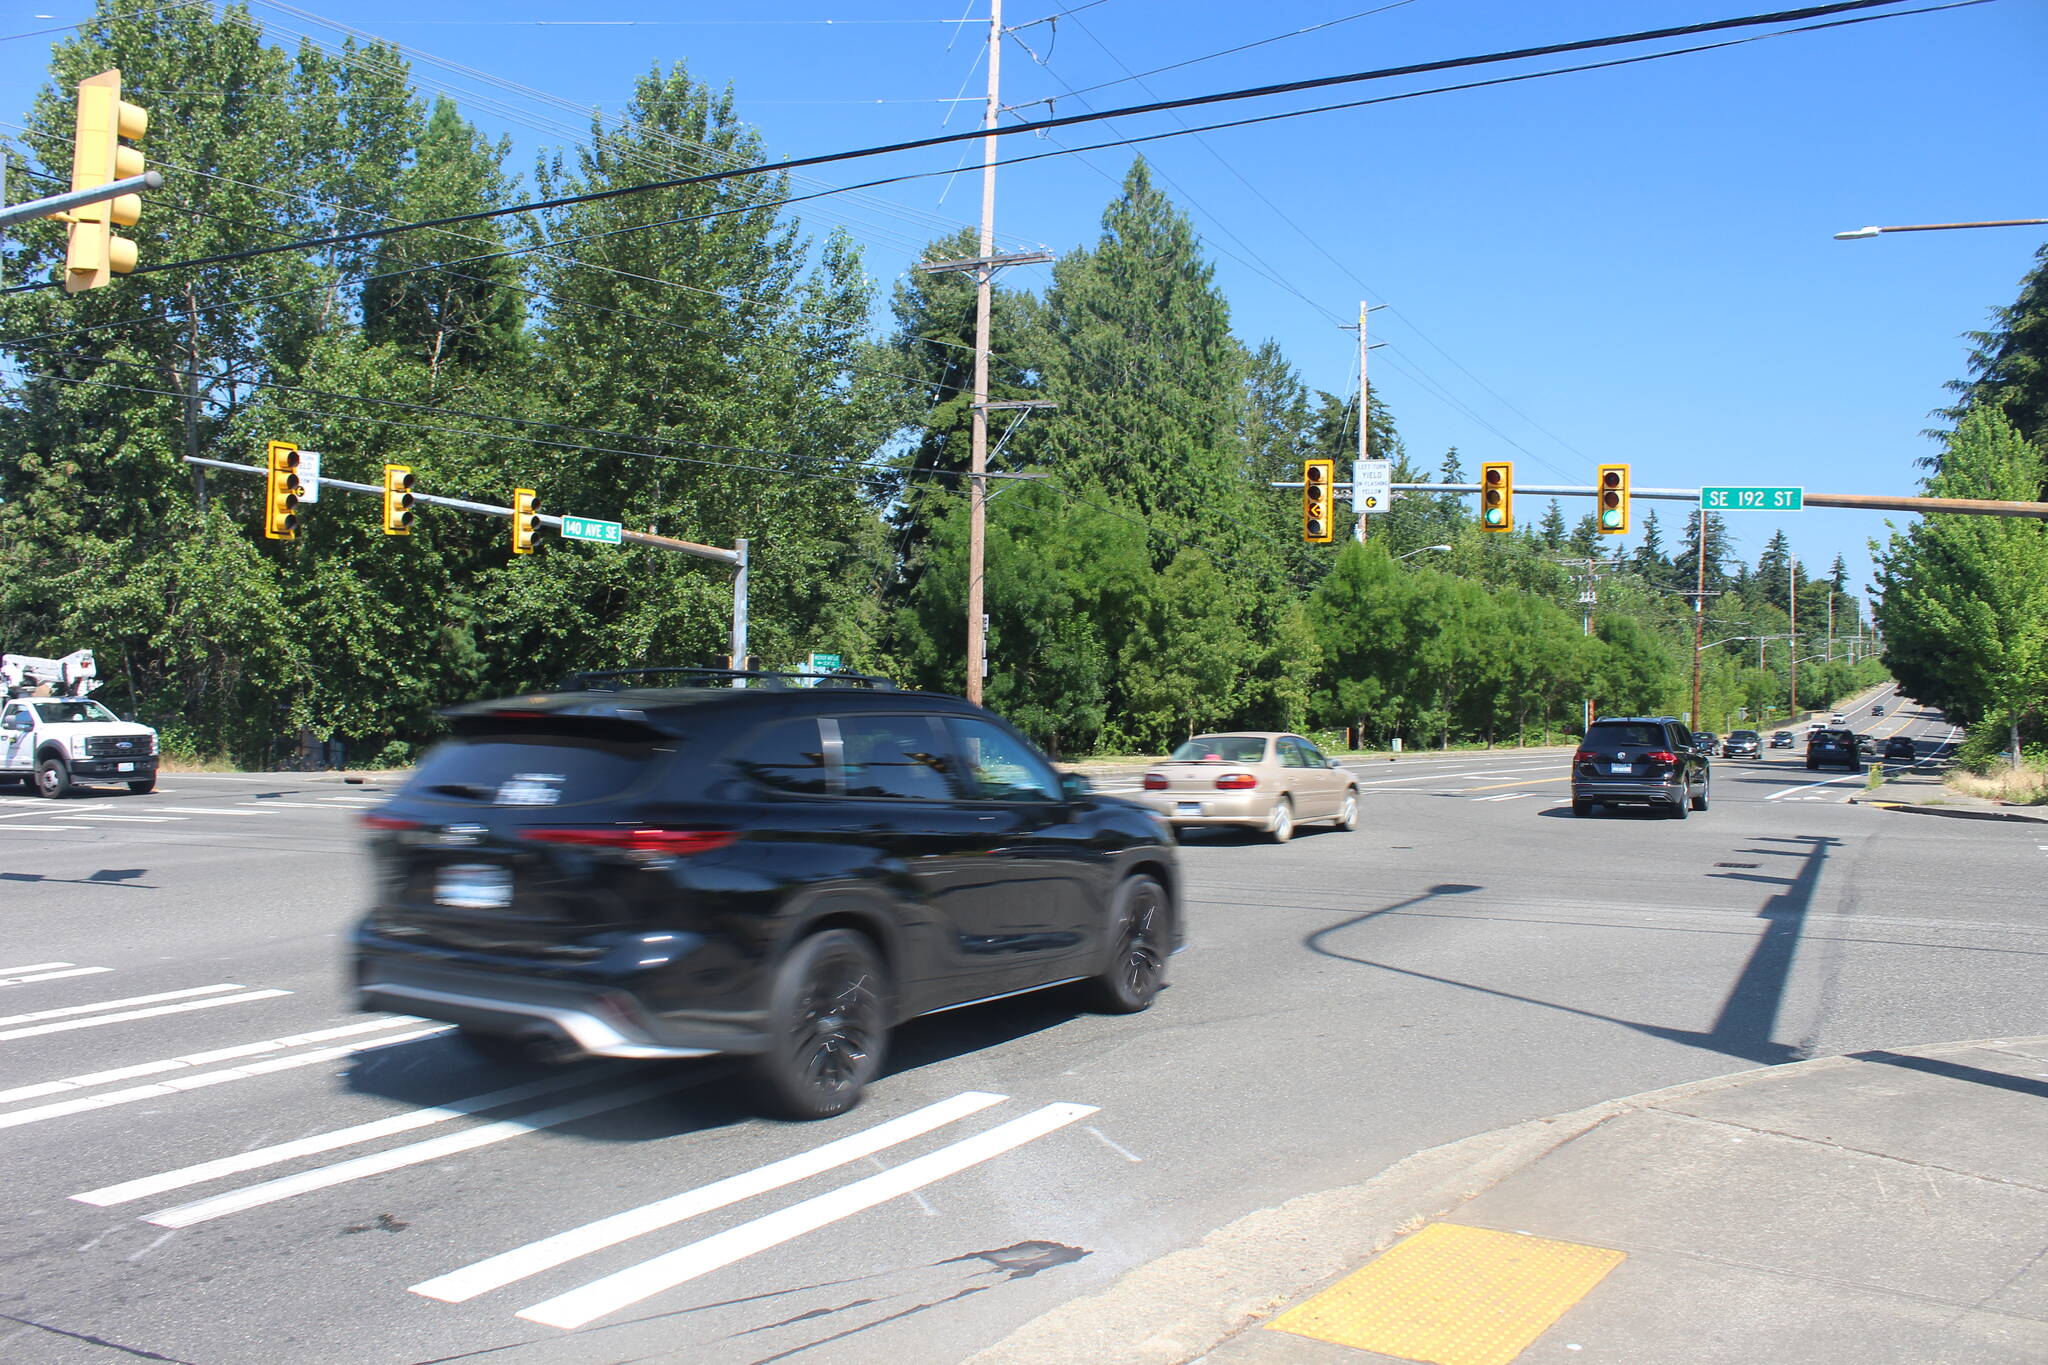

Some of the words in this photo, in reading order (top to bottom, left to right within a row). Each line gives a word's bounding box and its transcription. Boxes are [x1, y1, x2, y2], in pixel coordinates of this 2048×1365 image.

[1709, 491, 1728, 506] SE
[1738, 491, 1764, 506] 192
[1774, 491, 1793, 506] ST
[566, 520, 582, 535] 140
[585, 523, 602, 537] AVE
[606, 526, 617, 539] SE
